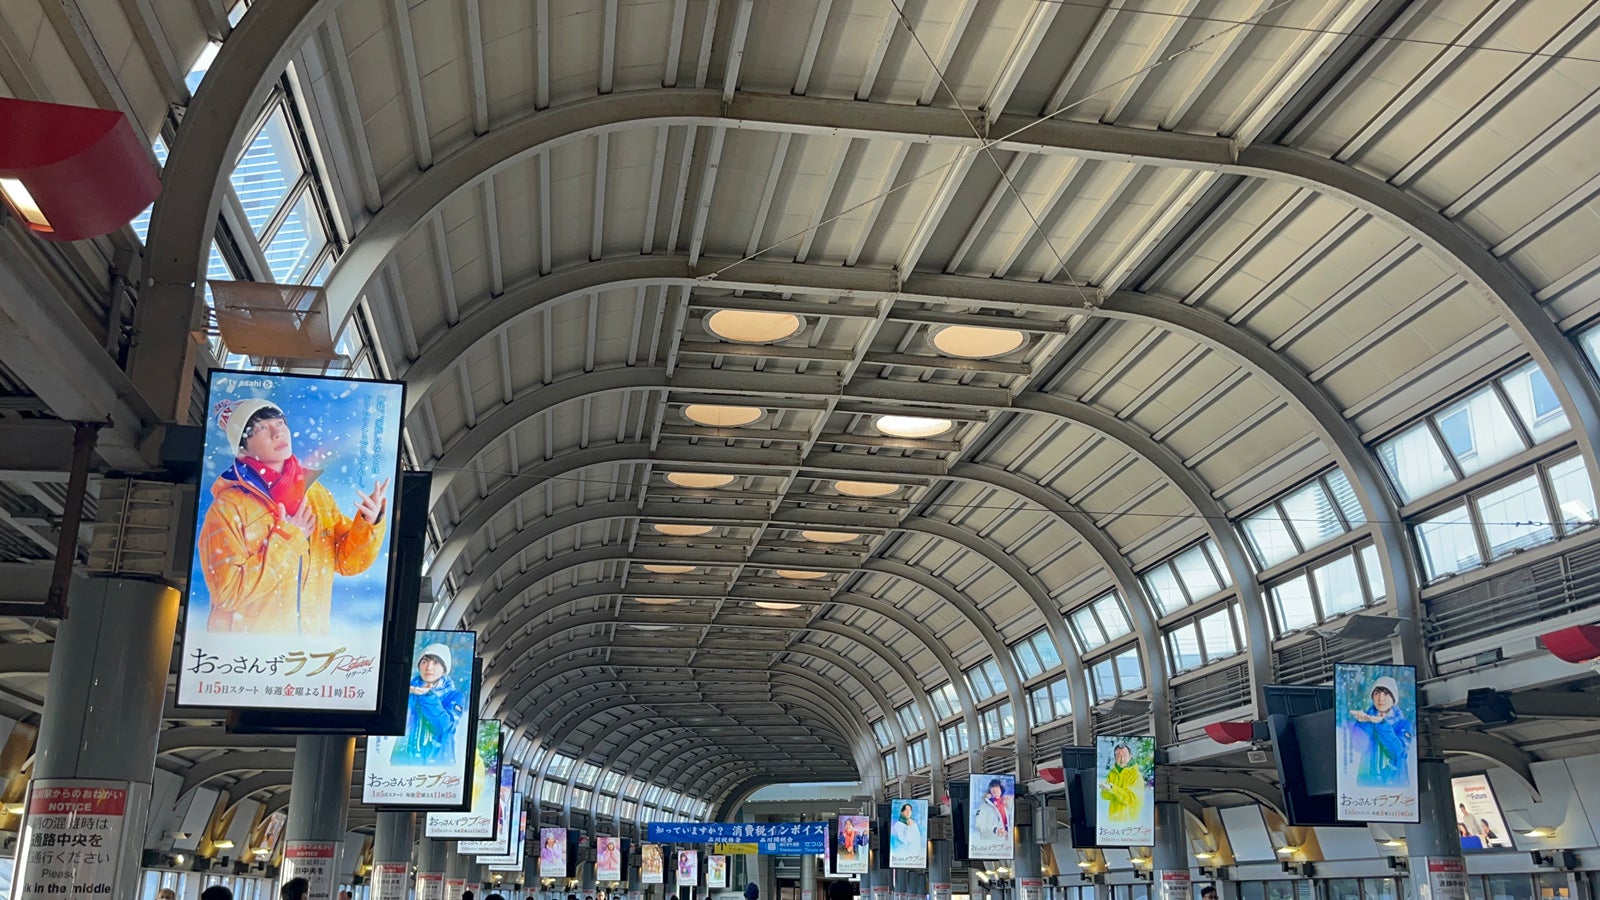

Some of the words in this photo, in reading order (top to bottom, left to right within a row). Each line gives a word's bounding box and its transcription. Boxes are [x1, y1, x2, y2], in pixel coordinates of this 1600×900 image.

[239, 380, 261, 388] asahi
[187, 647, 346, 677] おっさんずラブ
[198, 681, 259, 695] 1月5日スタート
[265, 684, 365, 698] 毎週金曜よる11時15分
[367, 772, 447, 788] おっさんずラブ
[48, 802, 92, 811] NOTICE
[656, 825, 723, 836] 知っていますか？
[732, 824, 828, 837] 消費税インボイス
[31, 832, 103, 847] 通路中央を
[42, 868, 77, 879] Please
[34, 882, 44, 893] in
[48, 882, 67, 893] the
[73, 882, 111, 894] middle
